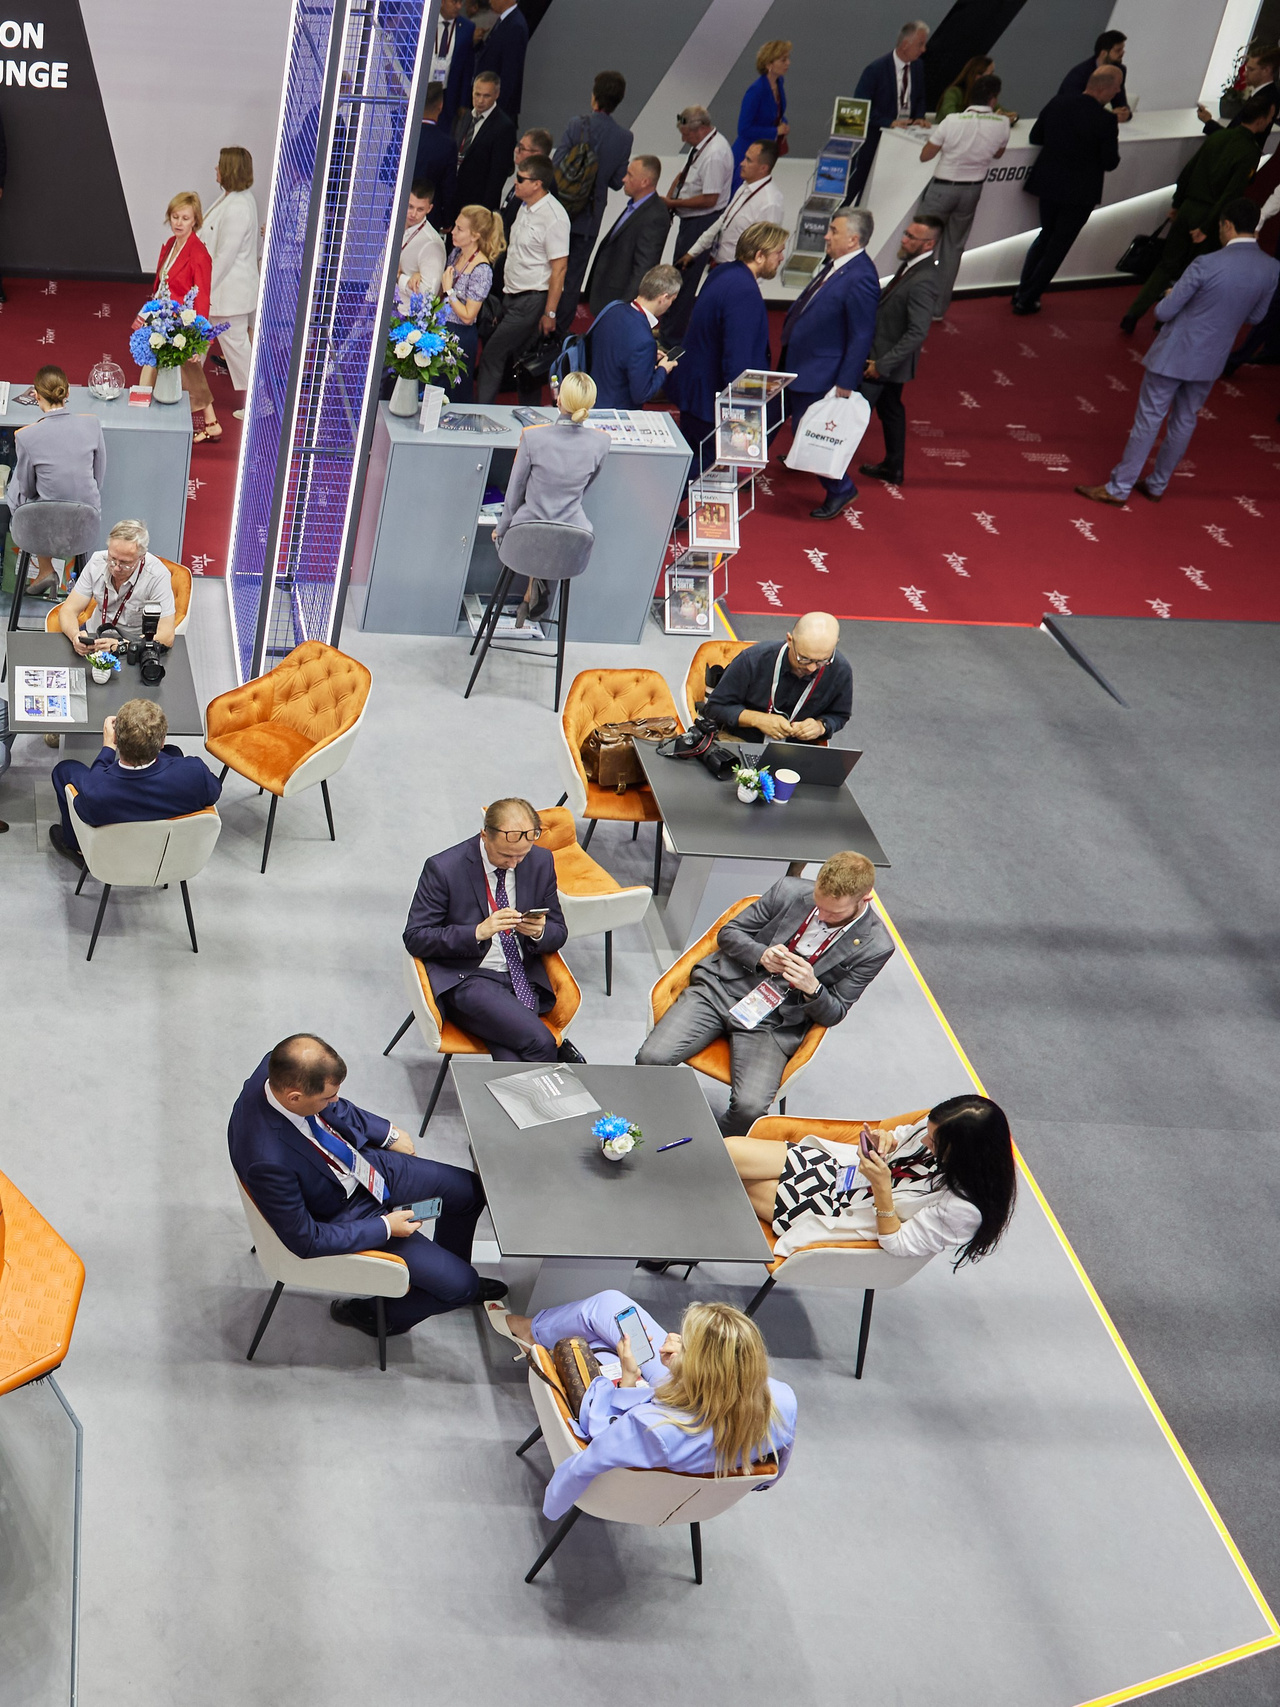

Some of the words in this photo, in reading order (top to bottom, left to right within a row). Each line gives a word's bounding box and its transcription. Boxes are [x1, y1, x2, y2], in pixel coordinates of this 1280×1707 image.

[805, 429, 844, 446] Военторг
[971, 511, 1000, 535] ARMY
[803, 548, 829, 573] ARMY
[942, 553, 970, 577] ARMY
[1179, 565, 1212, 591] ARMY
[756, 581, 783, 607] ARMY
[898, 586, 928, 612] ARMY
